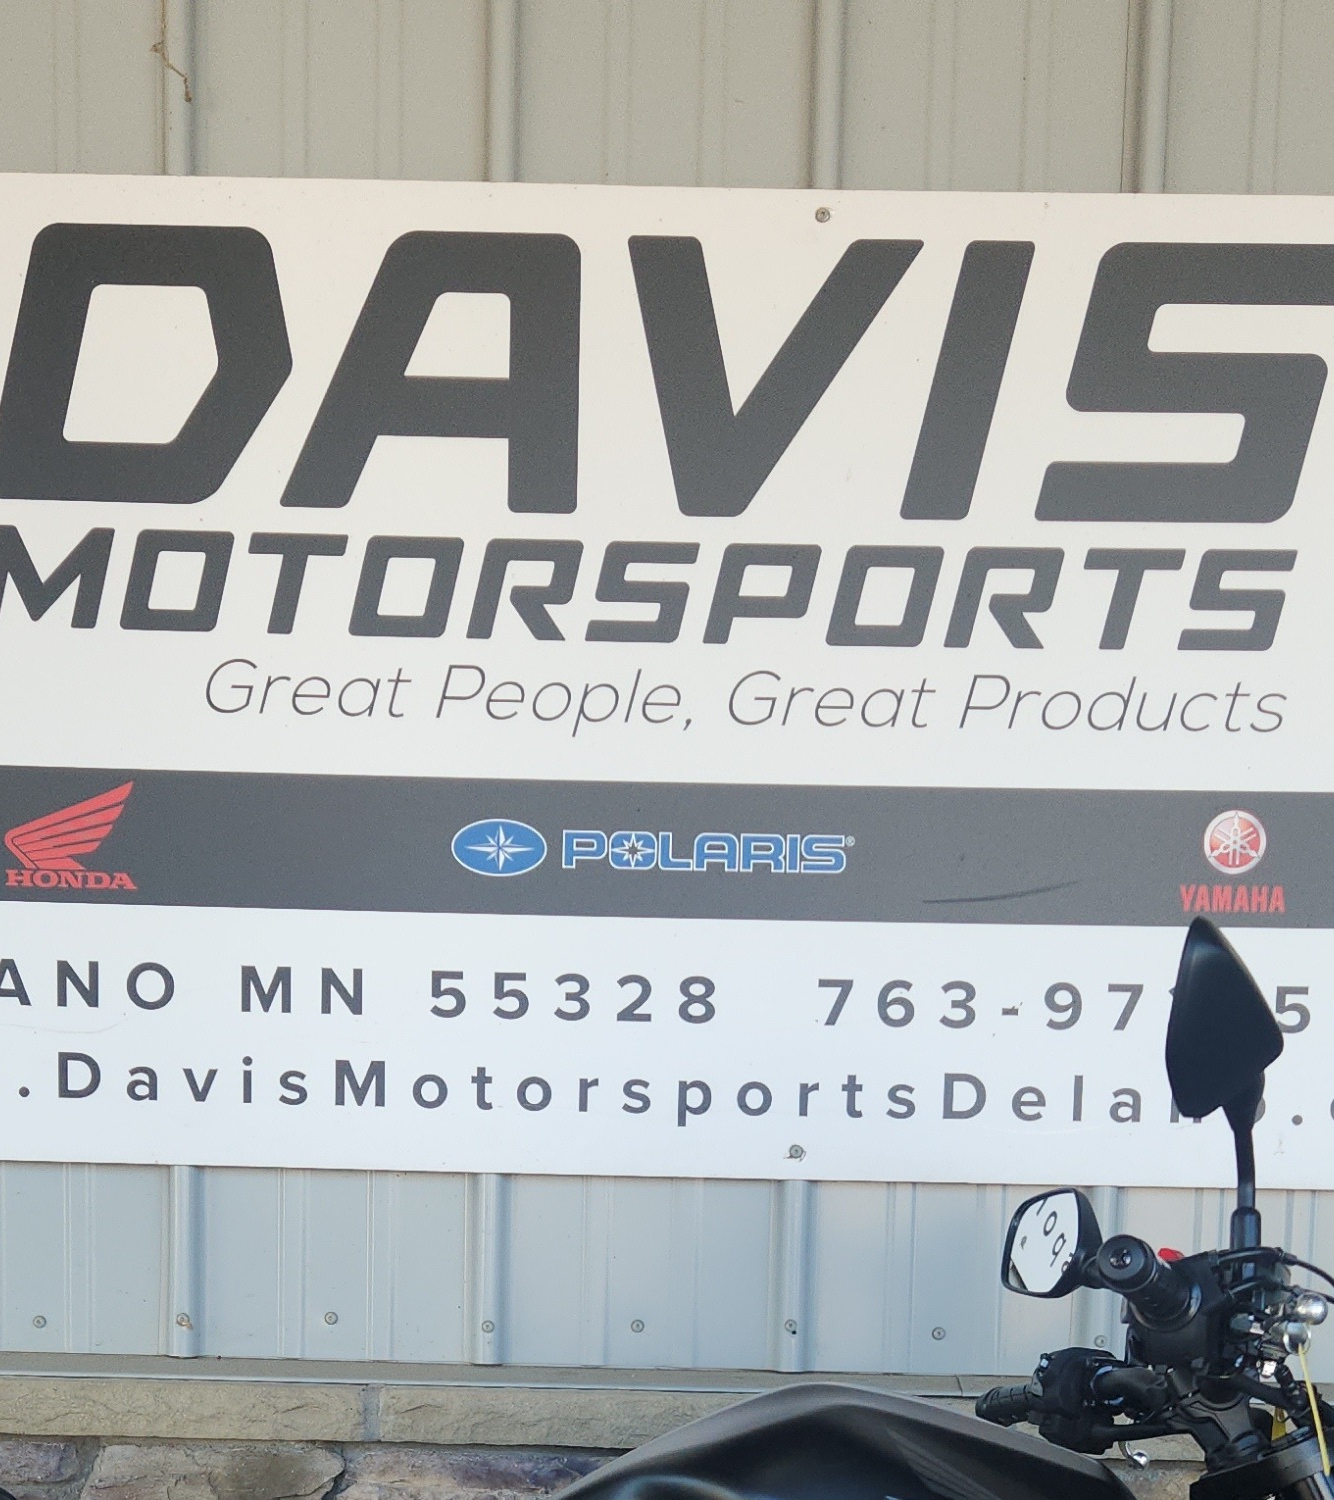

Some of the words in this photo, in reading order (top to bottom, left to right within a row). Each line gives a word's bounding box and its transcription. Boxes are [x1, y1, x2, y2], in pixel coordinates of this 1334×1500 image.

[205, 658, 412, 718] Great
[435, 664, 692, 738] People,
[728, 670, 936, 730] Great
[959, 674, 1287, 733] Products
[5, 868, 138, 890] HONDA
[1180, 884, 1286, 913] YAMAHA
[241, 965, 363, 1015] MN
[431, 970, 715, 1024] 55328
